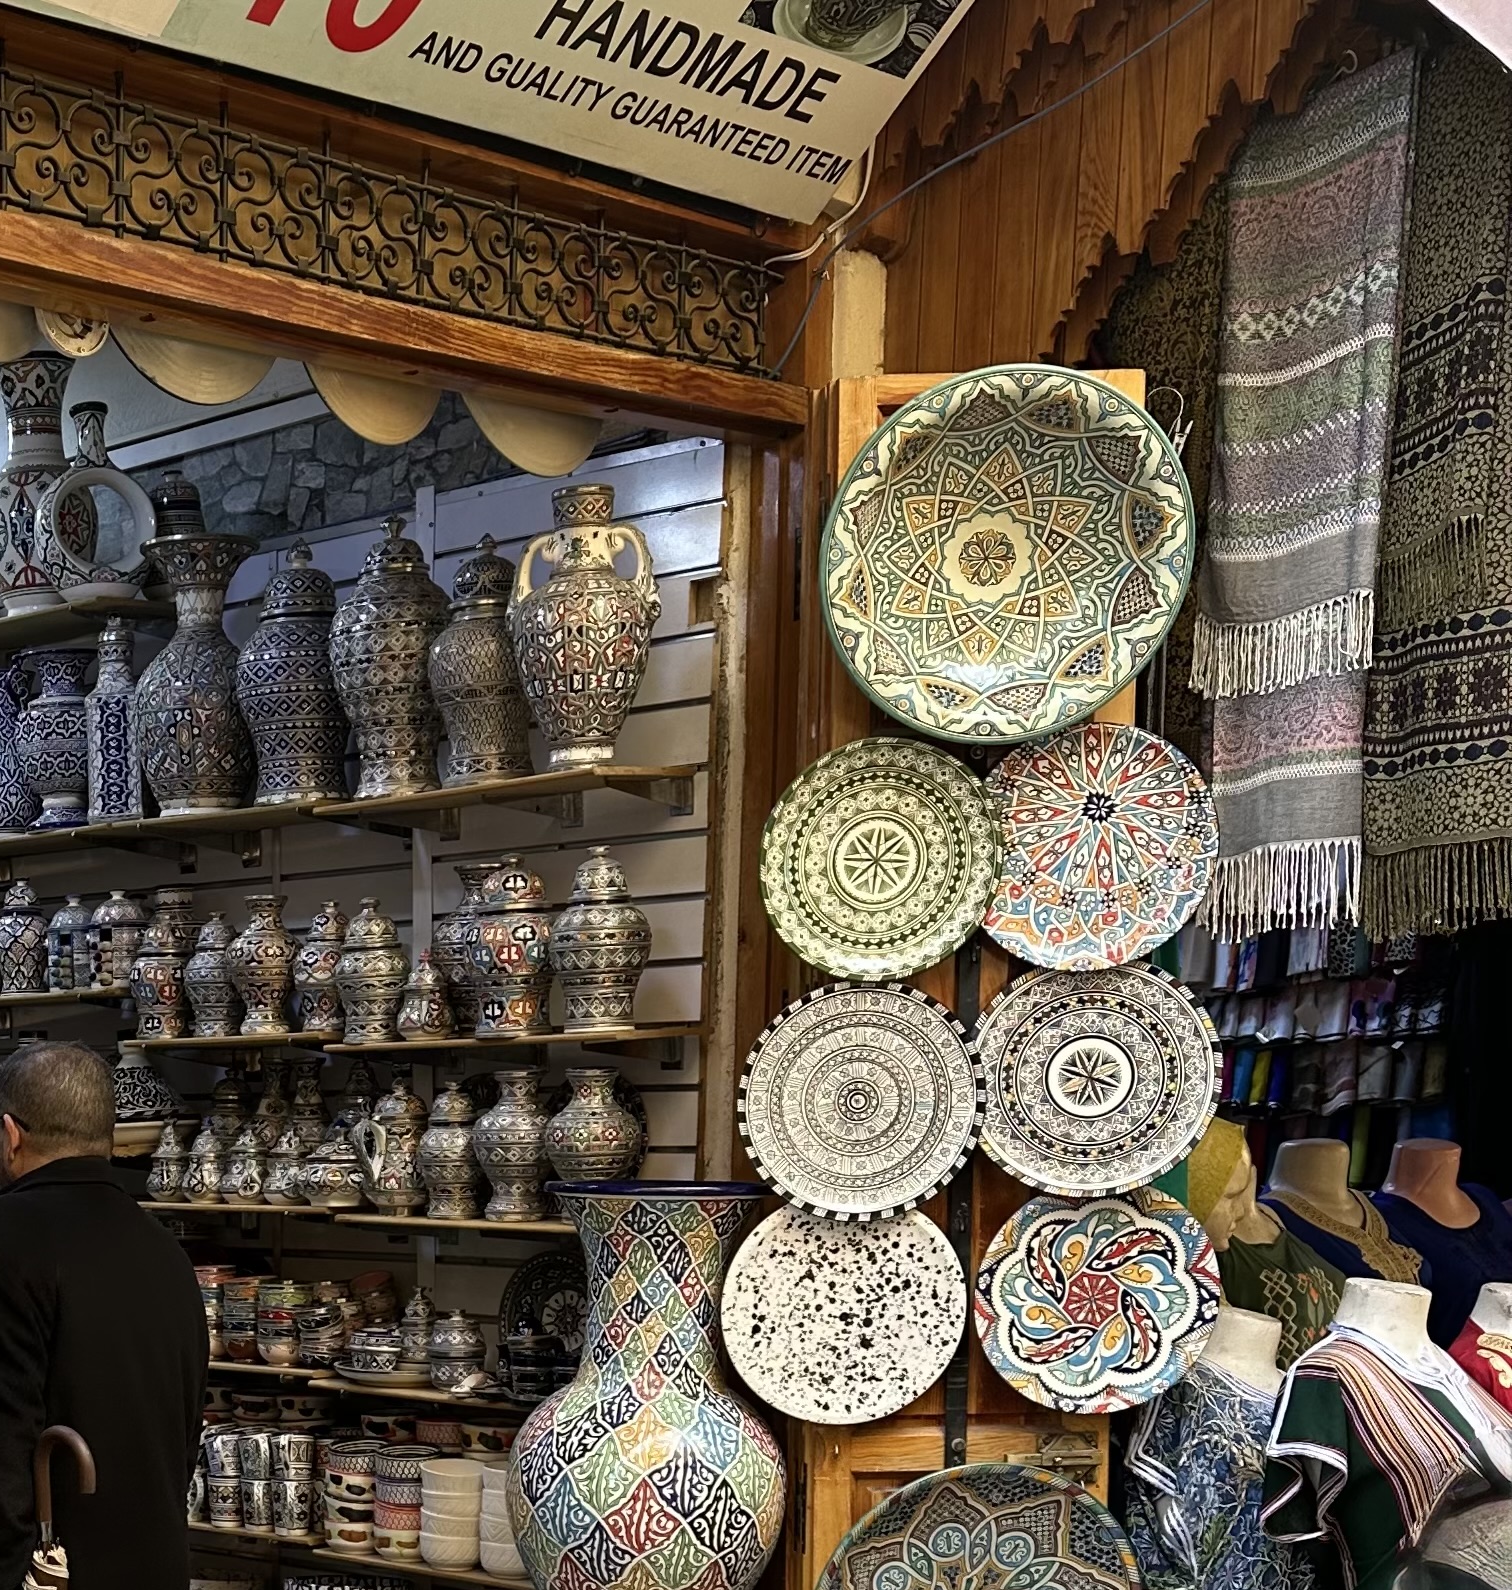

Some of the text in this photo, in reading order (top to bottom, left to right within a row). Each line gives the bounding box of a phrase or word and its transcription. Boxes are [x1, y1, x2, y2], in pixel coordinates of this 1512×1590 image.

[408, 31, 853, 185] AND GUALITY GUARANTEED ITEM
[534, 0, 841, 124] HANDMADE
